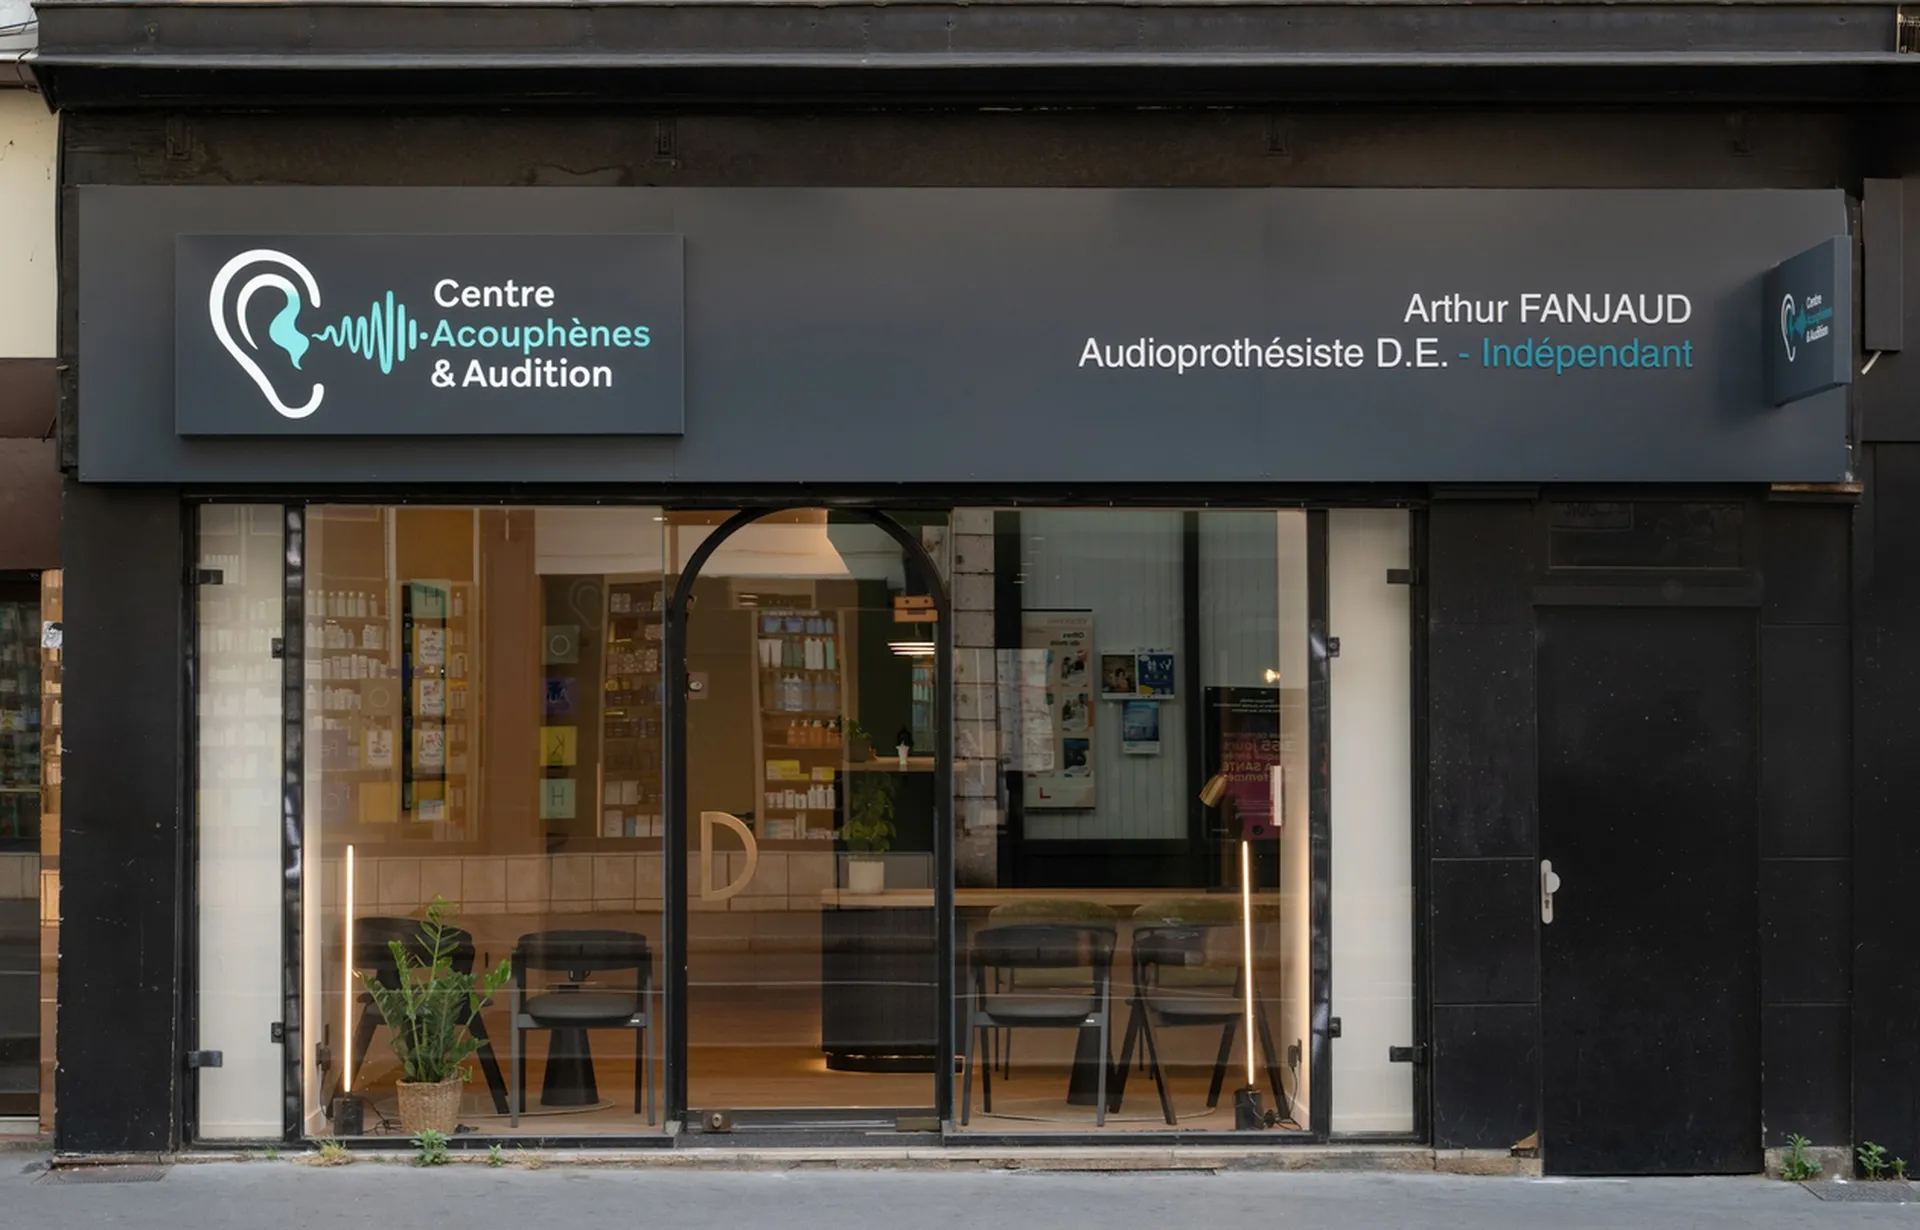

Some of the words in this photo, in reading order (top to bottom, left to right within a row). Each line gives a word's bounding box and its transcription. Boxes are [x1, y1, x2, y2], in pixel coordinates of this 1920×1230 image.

[433, 278, 556, 308] Centre
[1403, 292, 1511, 324] Arthur
[1520, 292, 1693, 325] FANJAUD
[430, 316, 651, 355] Acouphènes
[1077, 336, 1365, 375] Audioprothésiste
[1376, 337, 1448, 368] D.E.
[1483, 336, 1693, 375] Indépendant
[430, 358, 457, 389] &
[461, 357, 613, 389] Audition
